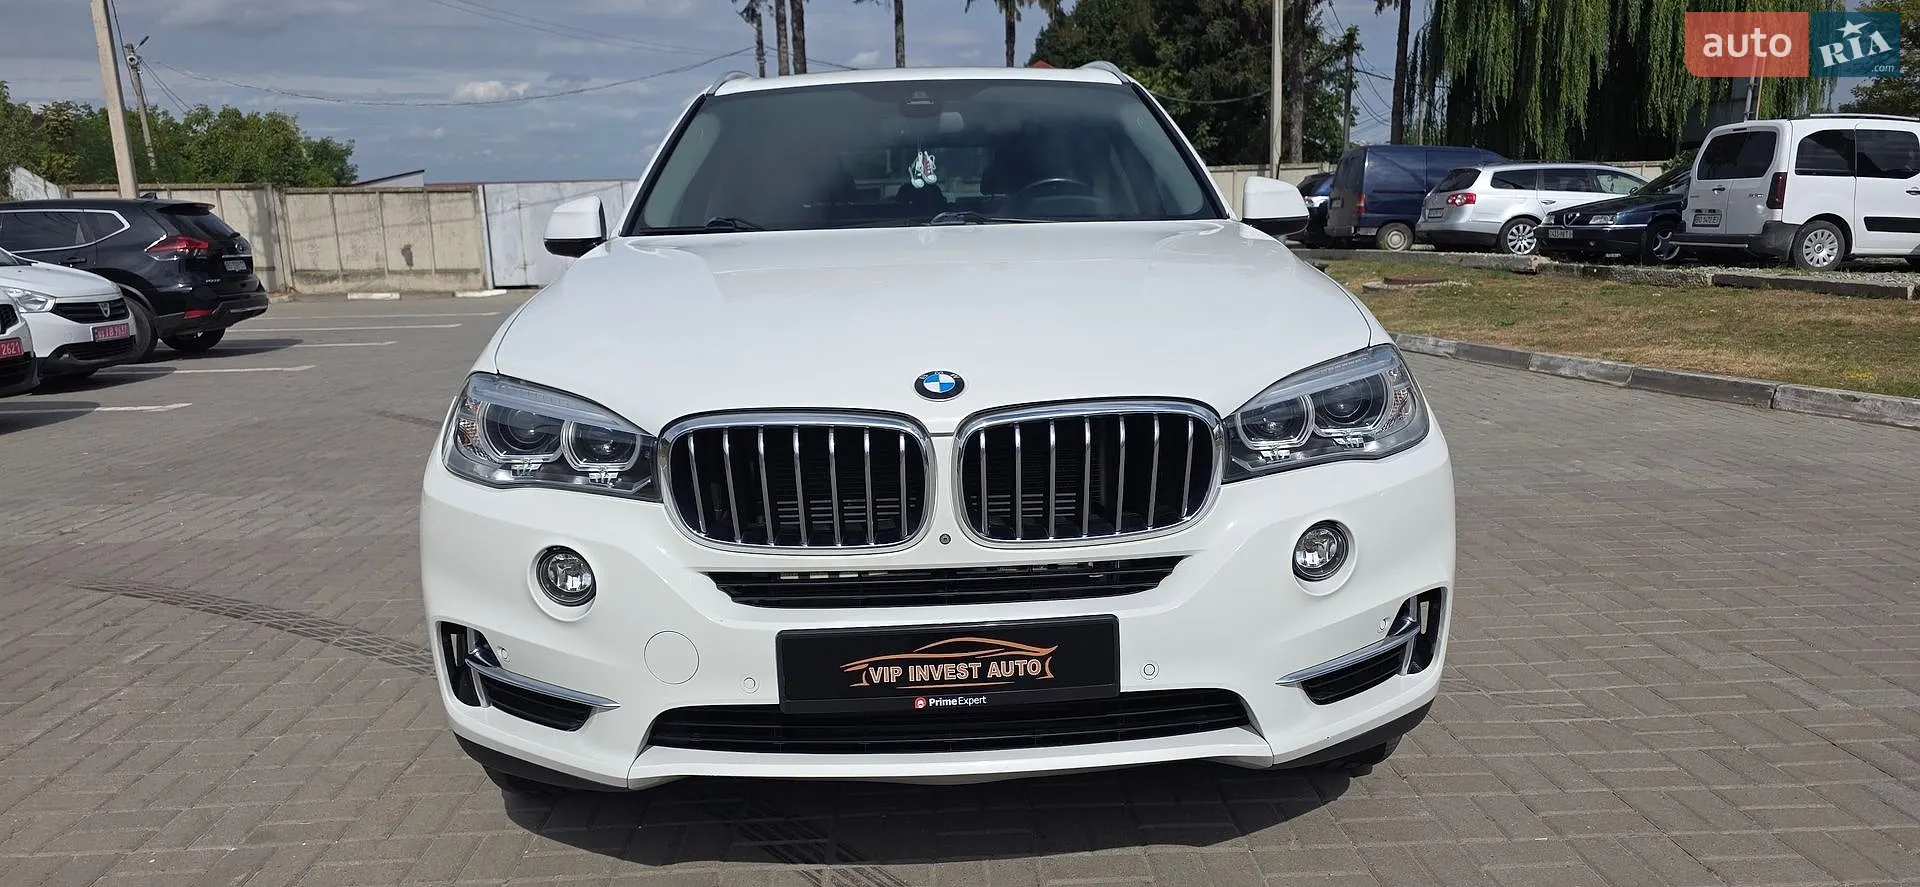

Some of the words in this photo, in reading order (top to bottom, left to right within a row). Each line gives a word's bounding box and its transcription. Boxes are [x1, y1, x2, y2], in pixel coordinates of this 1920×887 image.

[1, 342, 21, 355] 2621
[869, 667, 903, 683] VIP
[908, 662, 982, 682] INVEST
[987, 658, 1041, 678] AUTO
